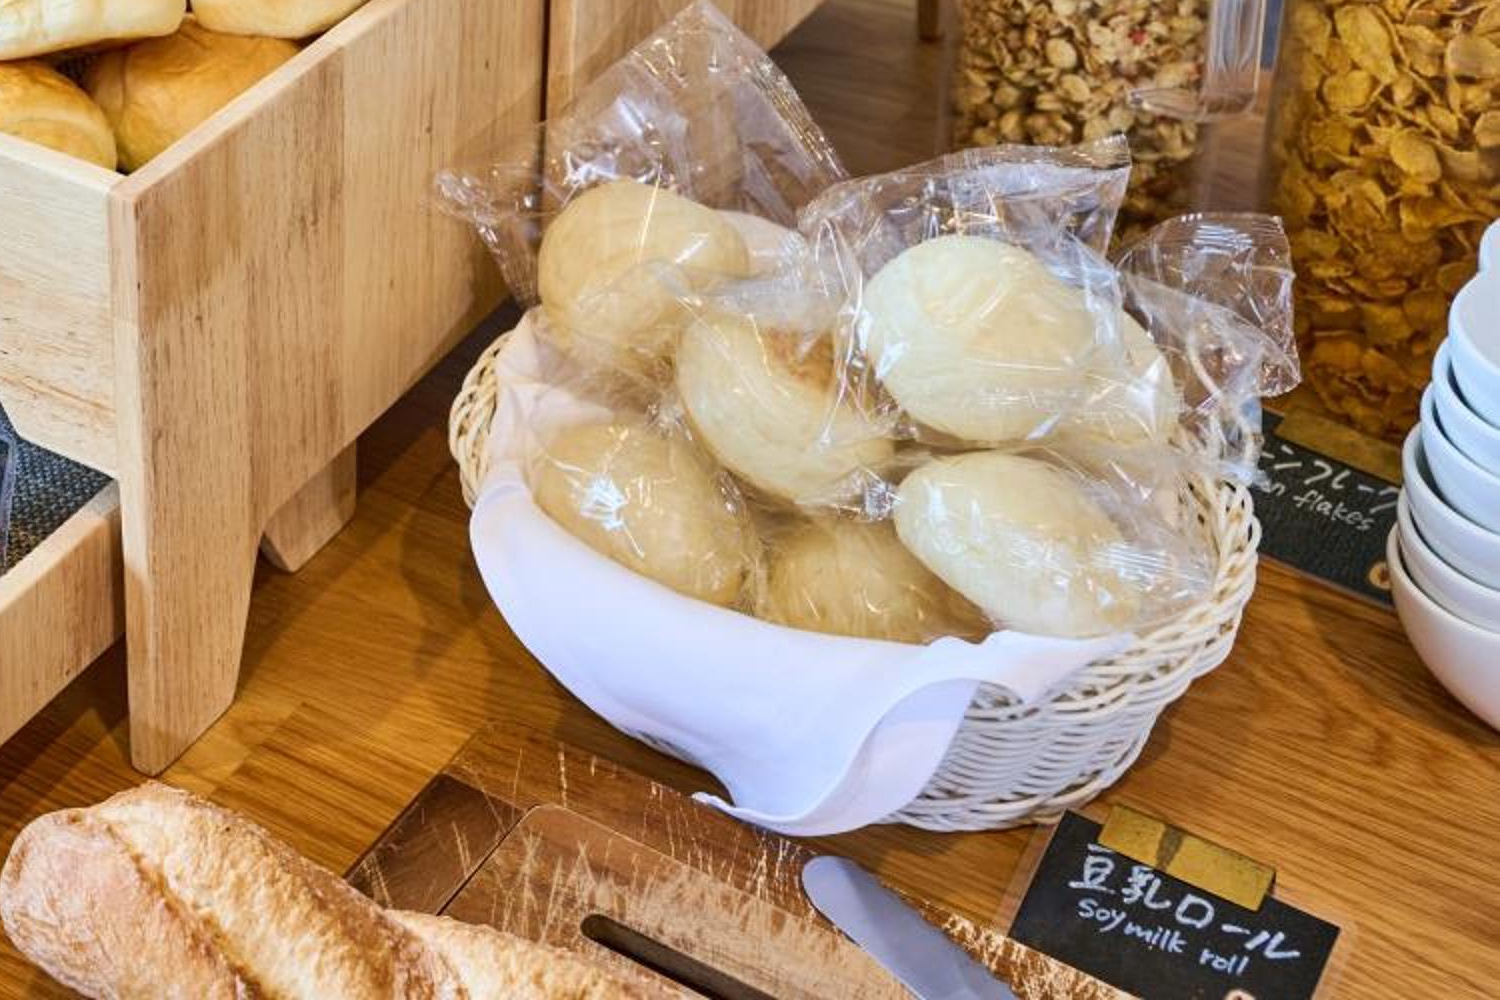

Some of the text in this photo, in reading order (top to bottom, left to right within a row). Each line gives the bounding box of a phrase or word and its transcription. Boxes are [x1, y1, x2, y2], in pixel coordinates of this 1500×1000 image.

[1293, 489, 1375, 531] flakes
[1068, 842, 1301, 960] 豆乳ロール
[1123, 921, 1188, 954] milk
[1199, 947, 1249, 977] roll
